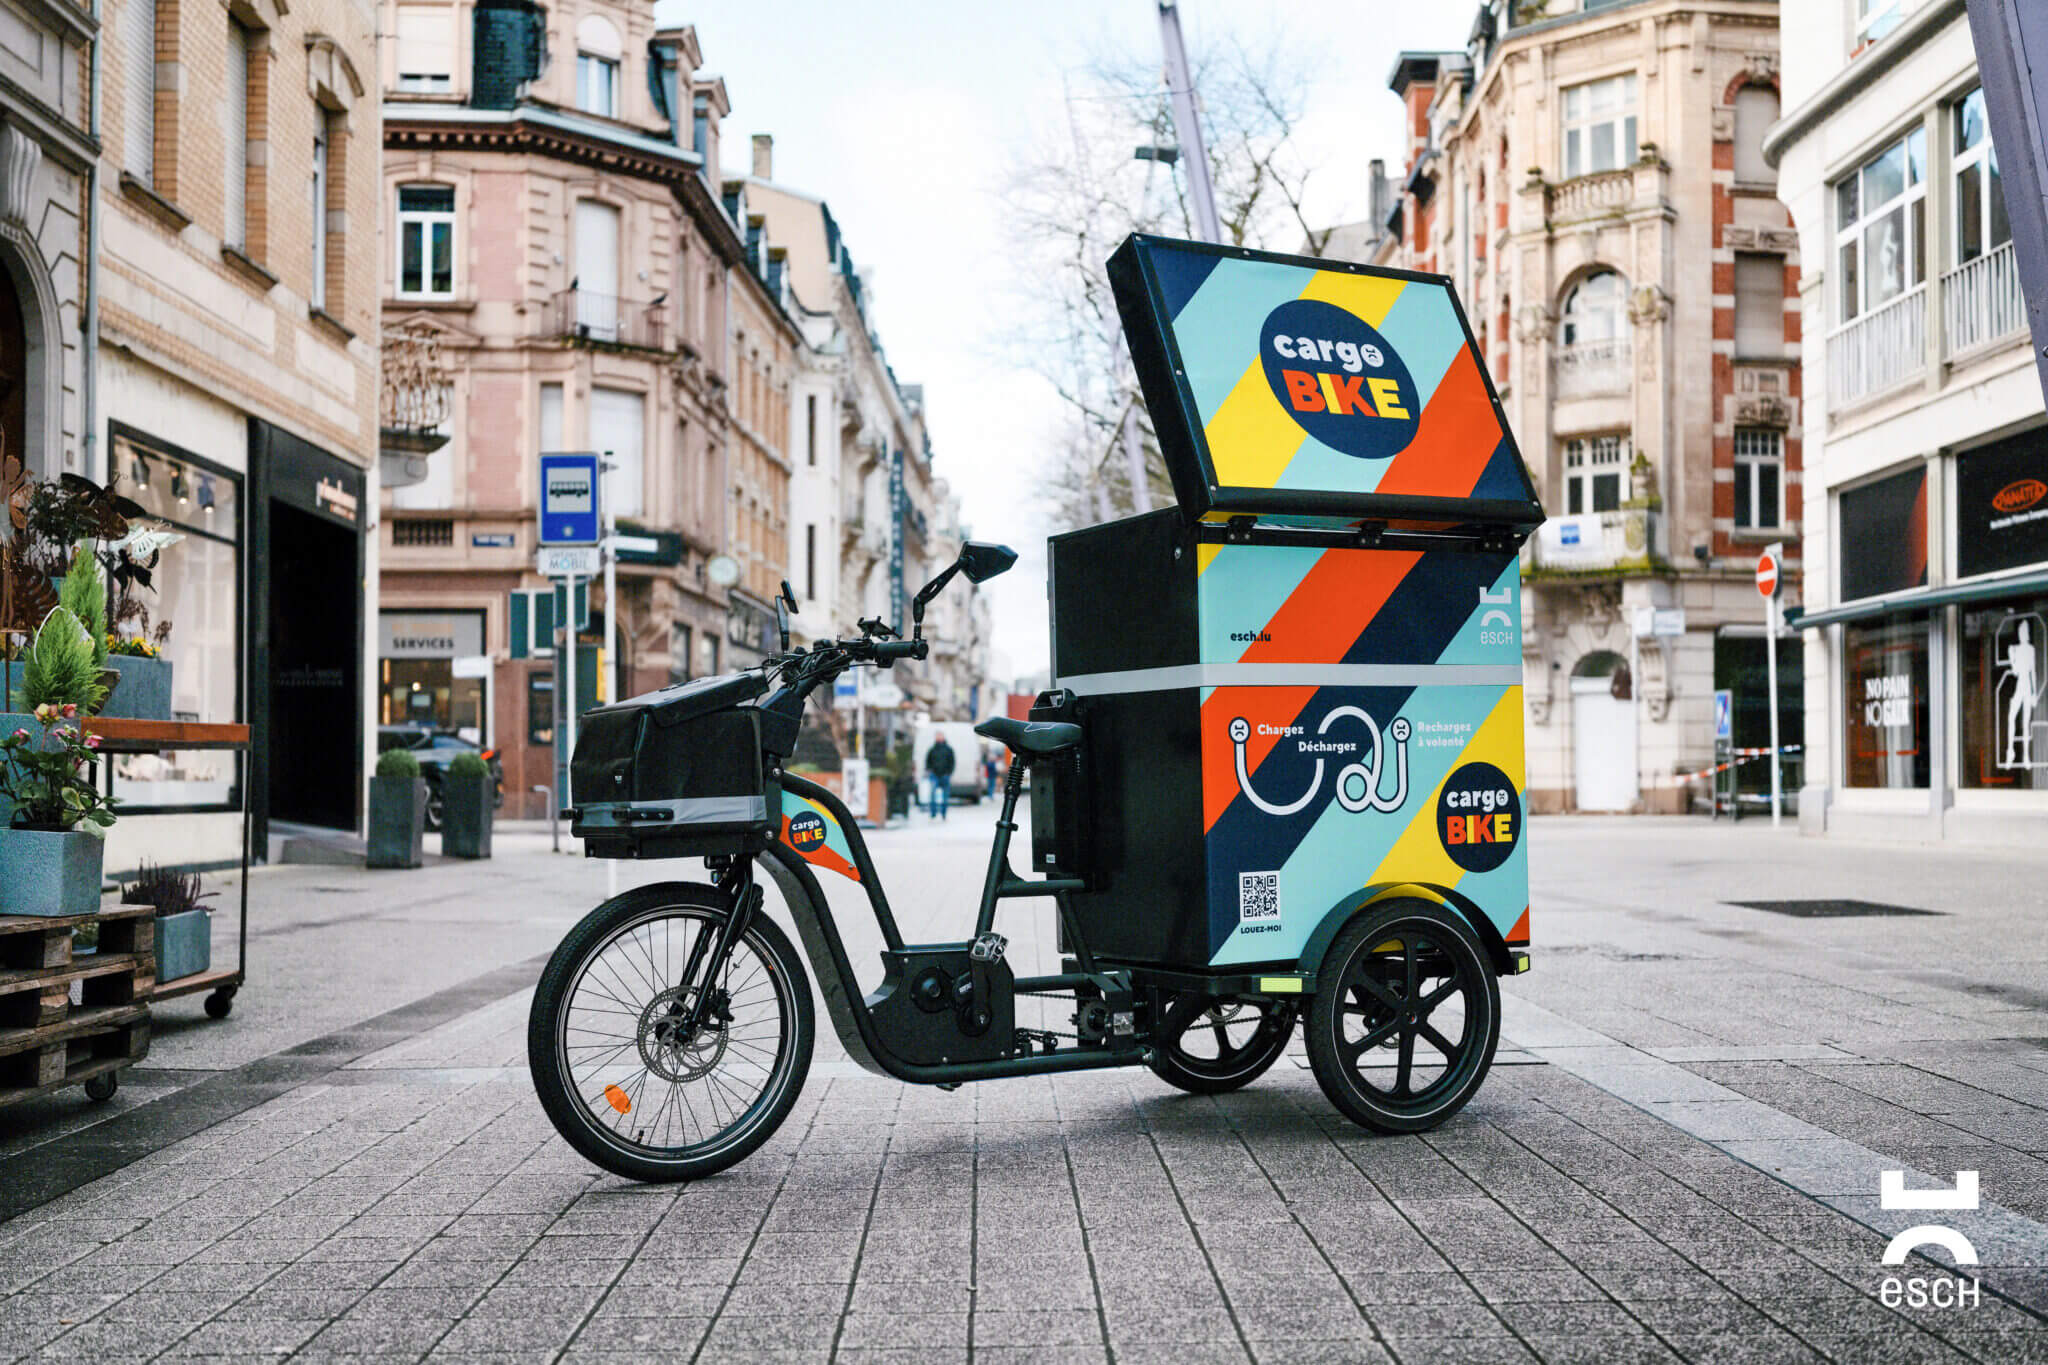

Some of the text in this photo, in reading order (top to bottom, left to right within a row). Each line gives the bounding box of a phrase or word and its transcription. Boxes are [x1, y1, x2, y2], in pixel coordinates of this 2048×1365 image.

[1273, 334, 1384, 373] cargo
[1281, 368, 1410, 420] BIKE
[1230, 629, 1272, 642] esch.lu
[393, 637, 455, 650] SERVICES
[1865, 674, 1910, 700] NO PAIN
[1865, 701, 1882, 727] NO
[1257, 723, 1304, 737] Chargez
[1417, 721, 1472, 735] Rechargez
[1298, 740, 1357, 754] Déchargez
[1417, 735, 1465, 747] à volonté
[1446, 788, 1509, 813] cargo
[791, 819, 820, 831] cargo
[1446, 813, 1513, 845] BIKE
[792, 828, 824, 845] BIKE
[1240, 924, 1283, 934] LOUEZ-MOI
